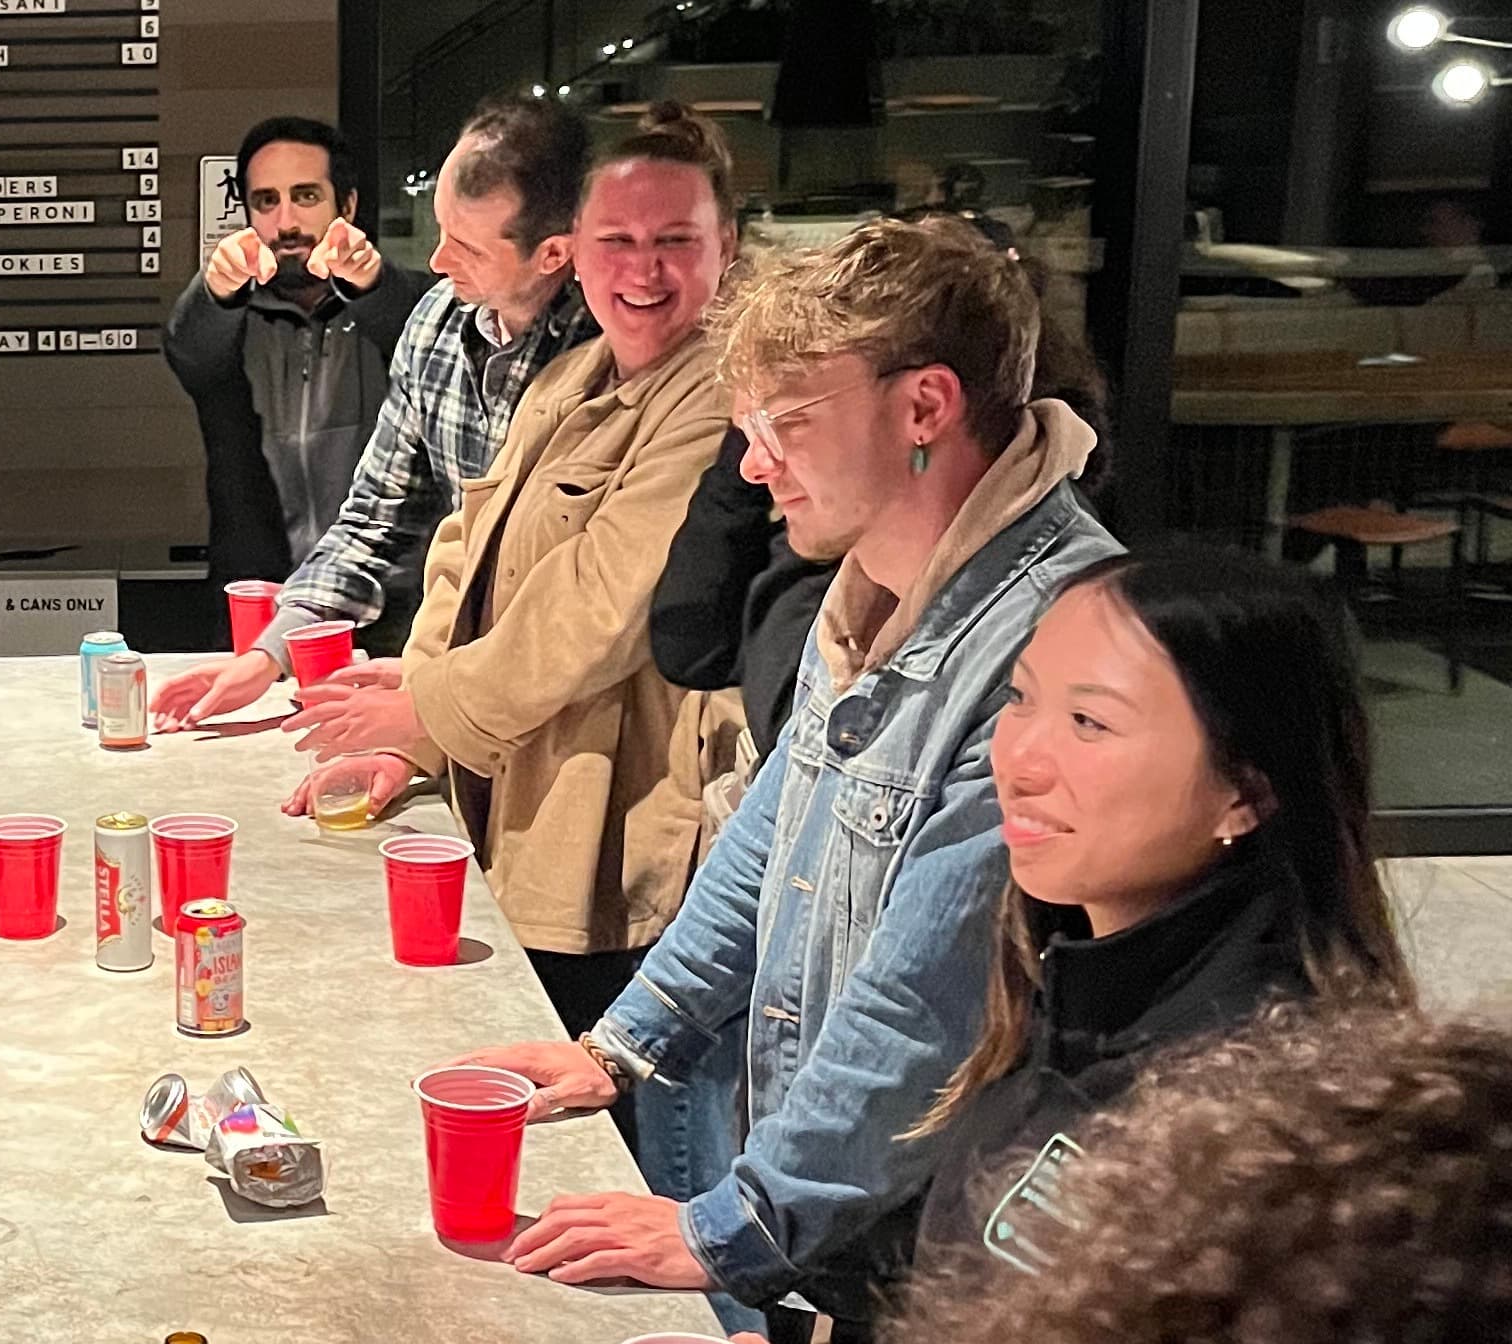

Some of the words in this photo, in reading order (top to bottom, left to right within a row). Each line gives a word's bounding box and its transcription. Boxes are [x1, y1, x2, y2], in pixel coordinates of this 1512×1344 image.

[145, 20, 155, 35] 6
[127, 46, 153, 61] 10
[127, 152, 154, 167] 14
[145, 178, 154, 193] 9
[130, 205, 158, 219] 15
[147, 231, 157, 245] 4
[145, 256, 155, 271] 4
[5, 598, 15, 611] &
[20, 598, 62, 611] CANS
[66, 598, 105, 611] ONLY
[97, 865, 112, 931] STELLA
